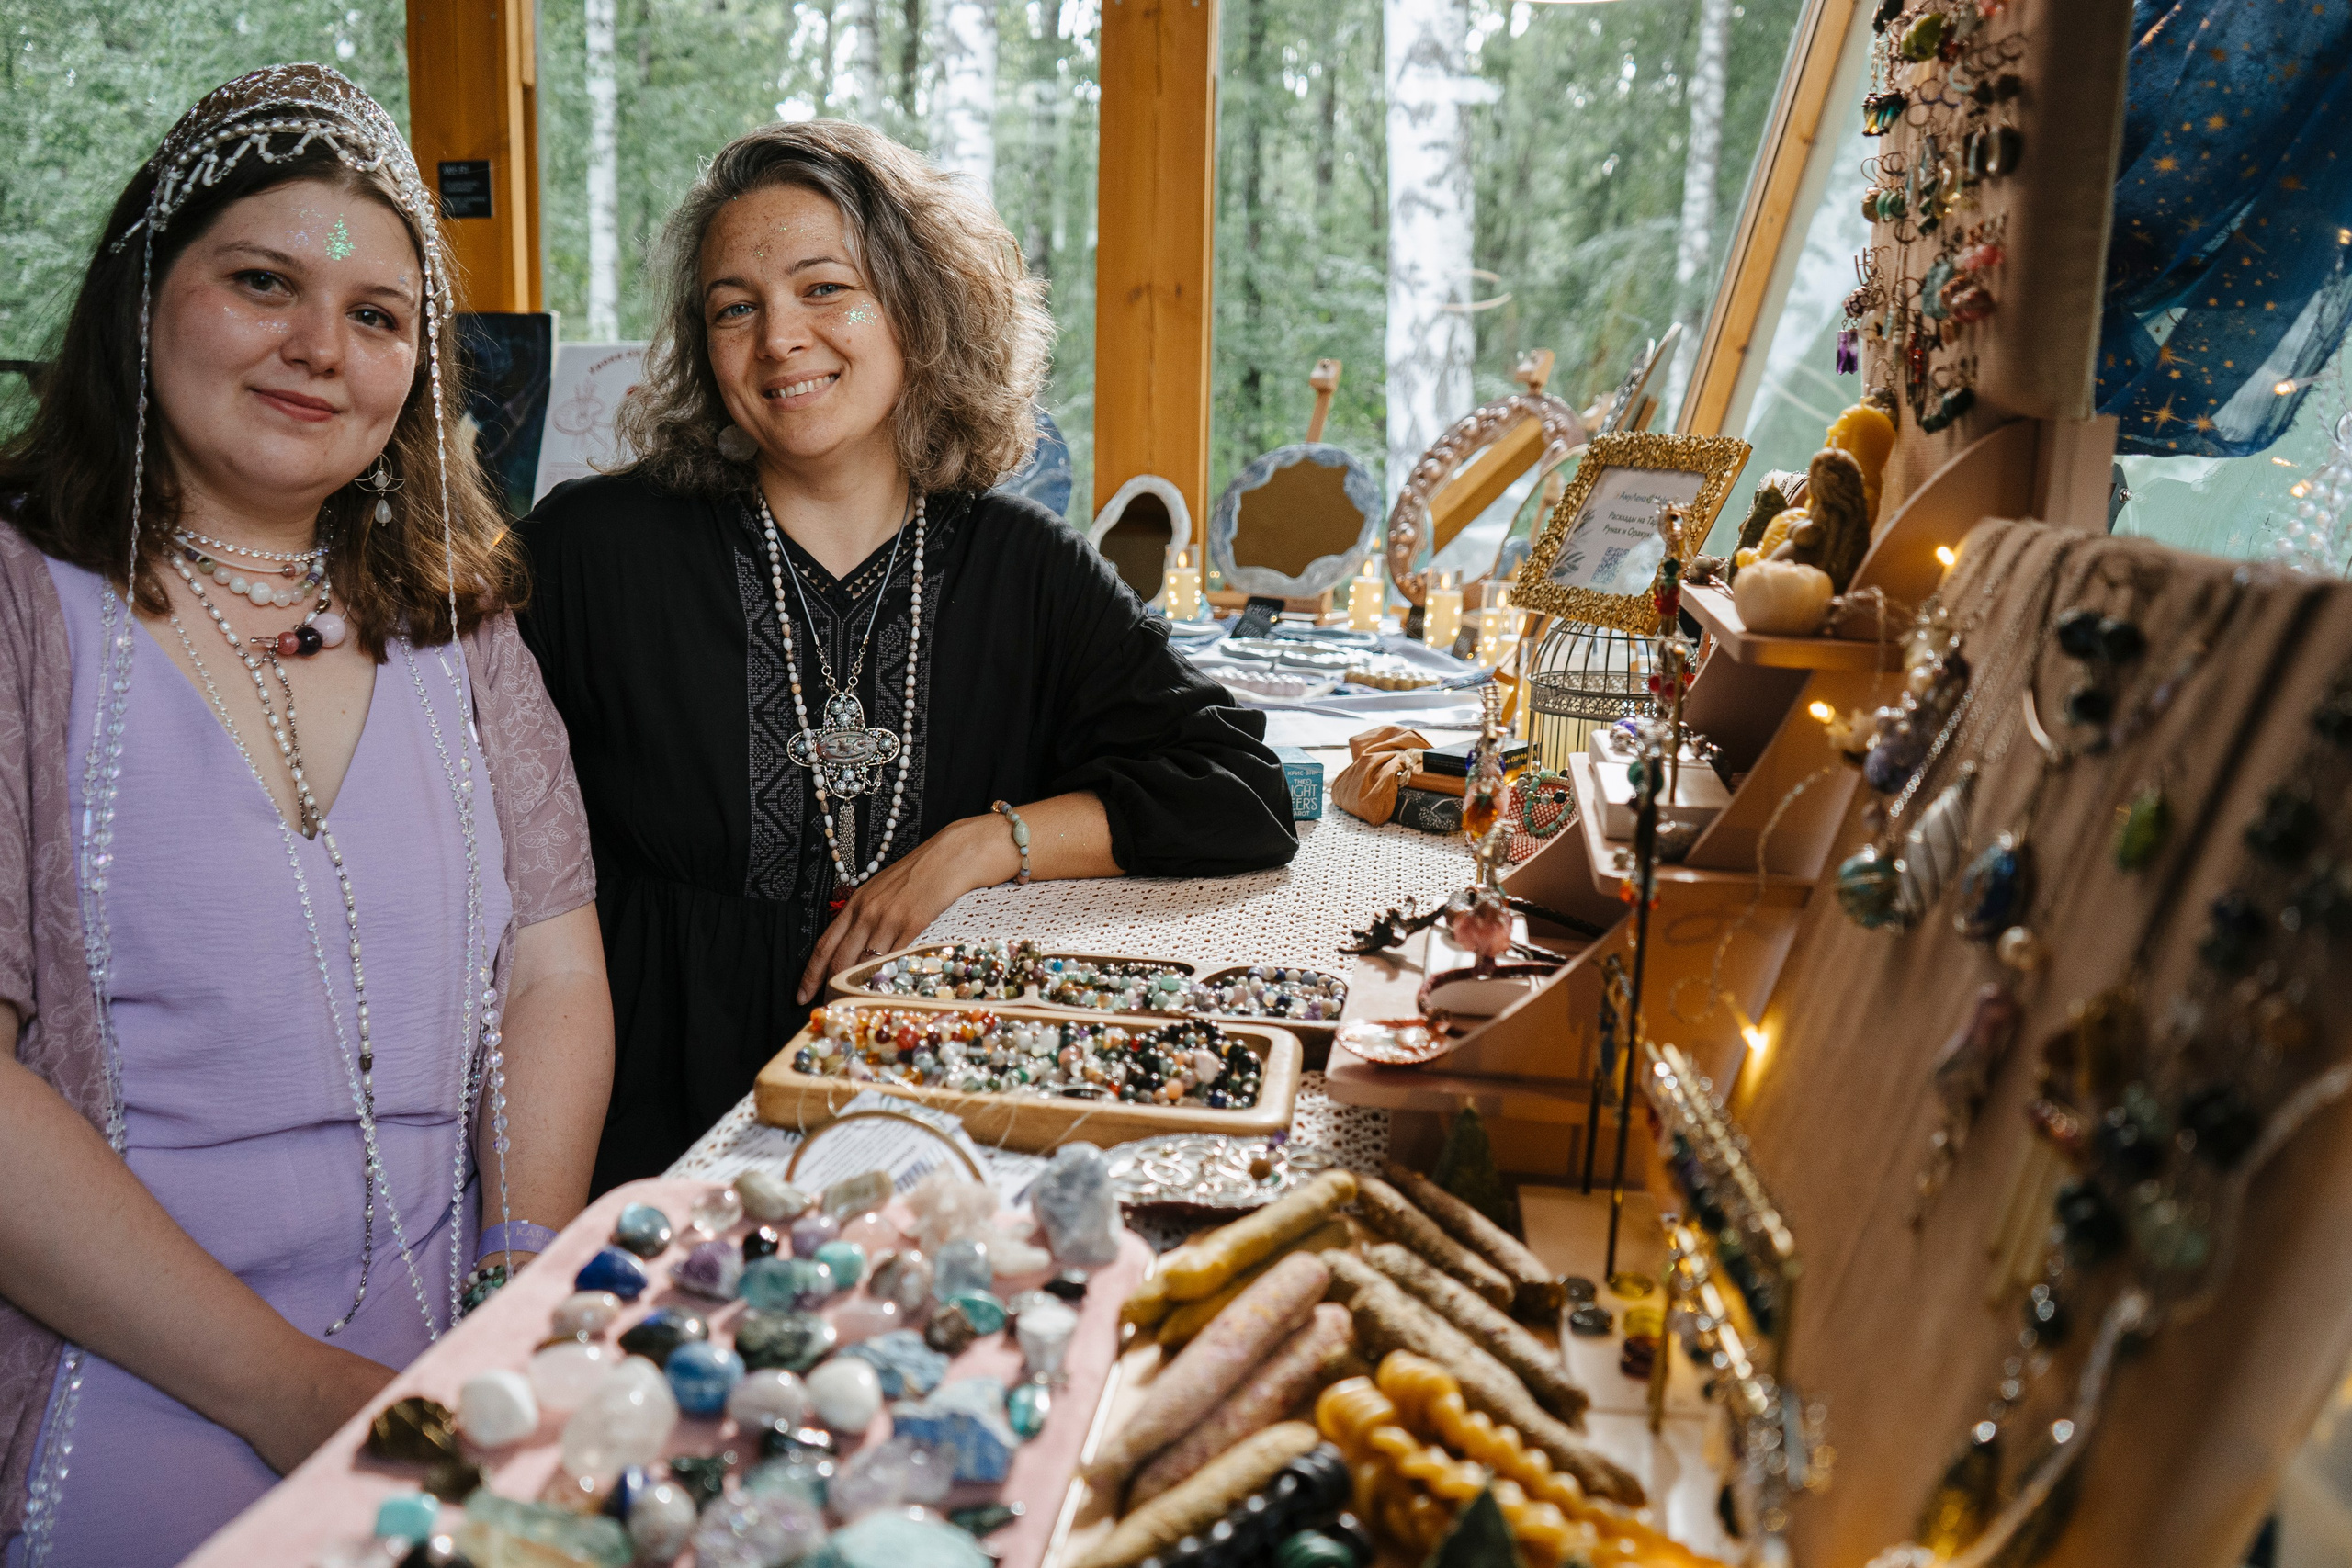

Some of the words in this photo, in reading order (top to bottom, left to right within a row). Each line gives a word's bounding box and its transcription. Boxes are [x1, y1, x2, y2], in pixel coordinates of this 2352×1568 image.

[1646, 515, 1657, 528] Тар
[1294, 778, 1313, 786] THE
[1291, 784, 1318, 797] IGHT
